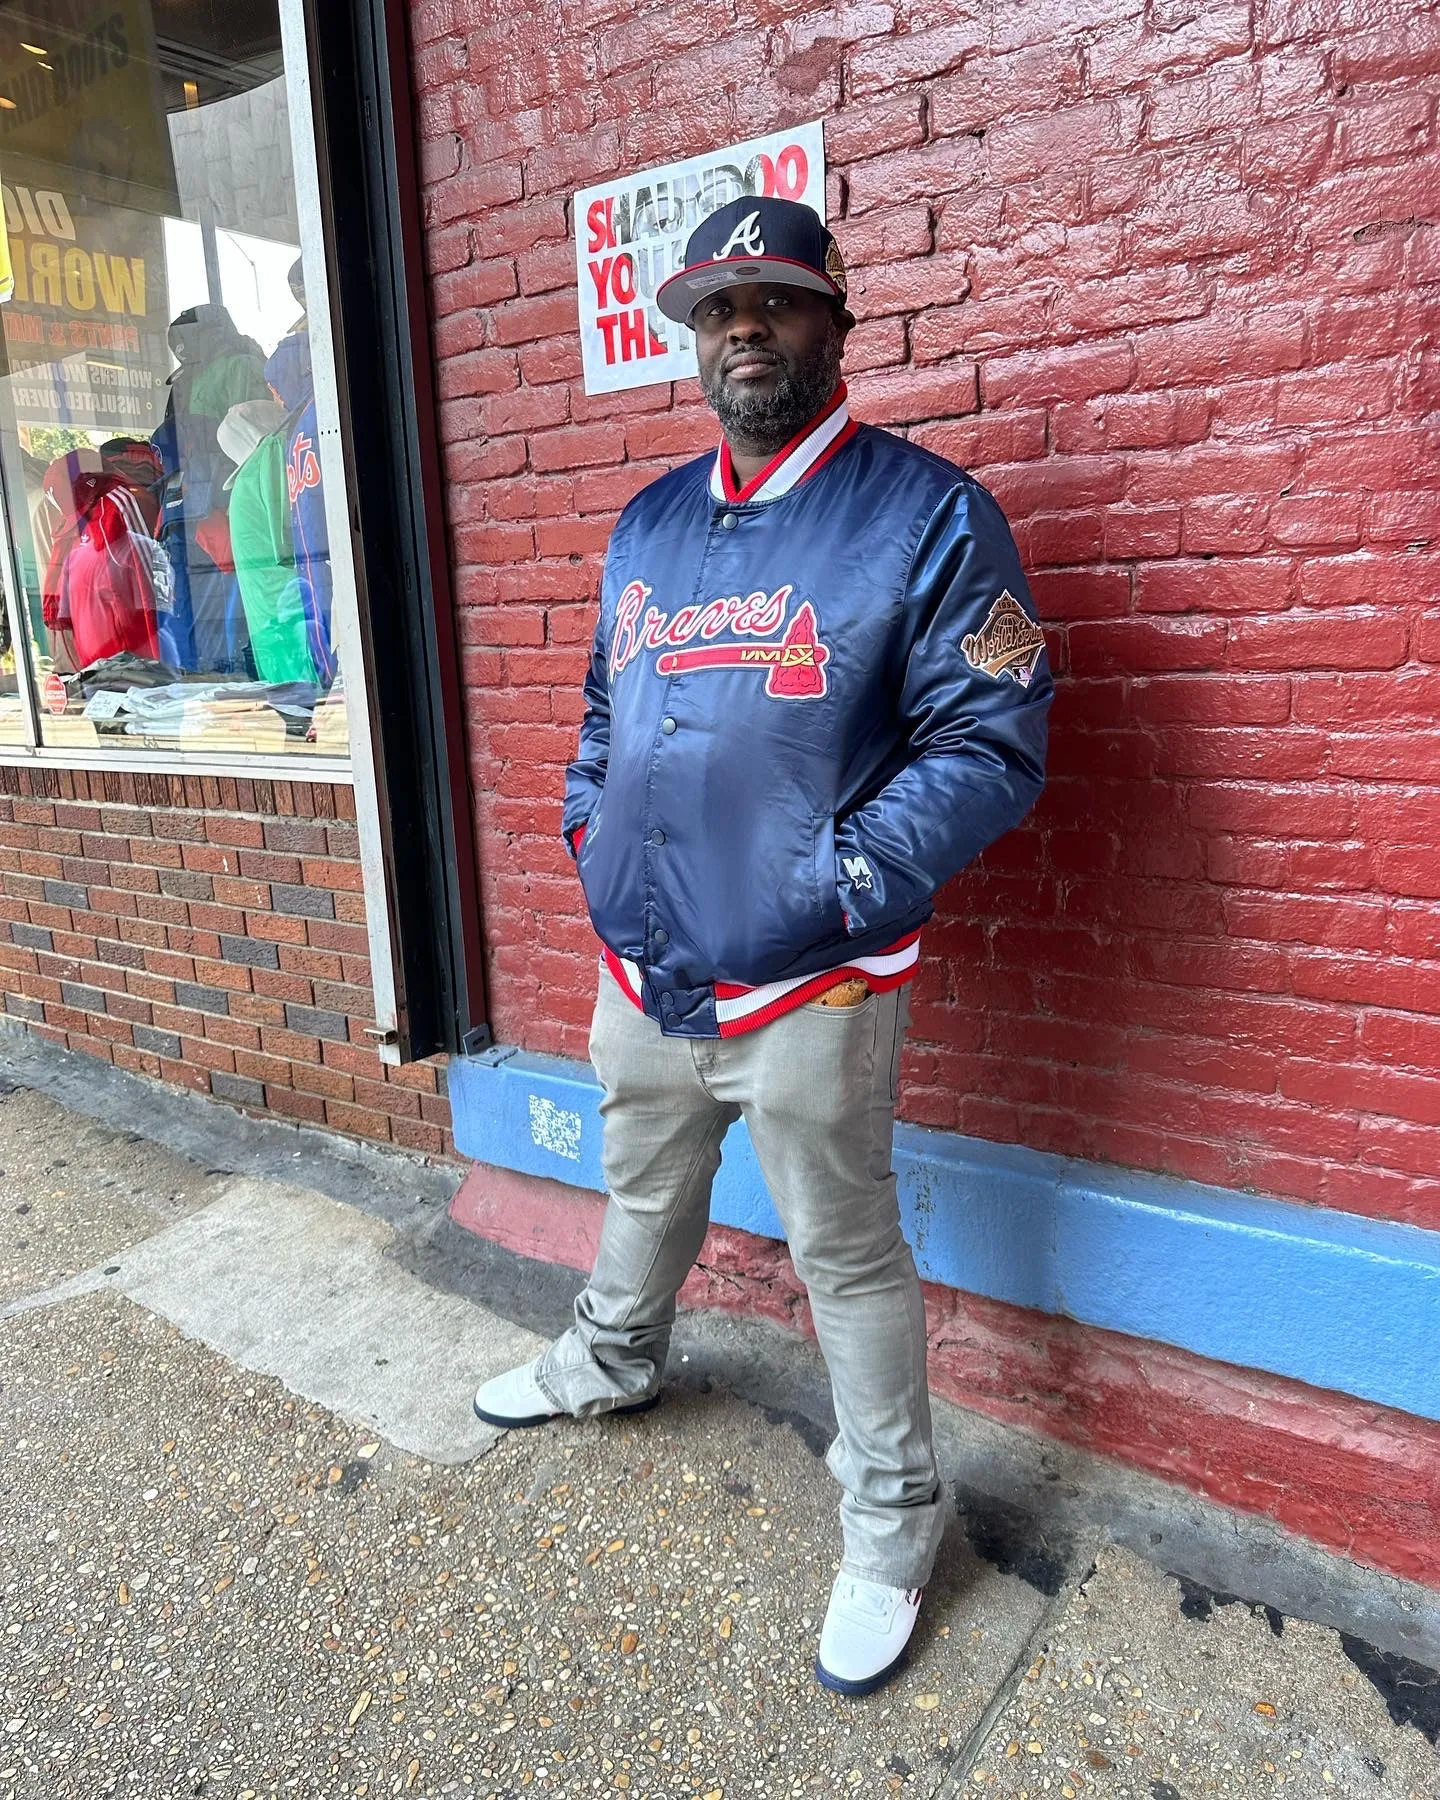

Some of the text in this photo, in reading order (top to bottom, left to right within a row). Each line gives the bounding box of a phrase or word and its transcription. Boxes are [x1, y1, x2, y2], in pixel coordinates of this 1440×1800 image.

[713, 211, 765, 260] A
[609, 580, 793, 683] Braves
[961, 620, 1017, 665] World
